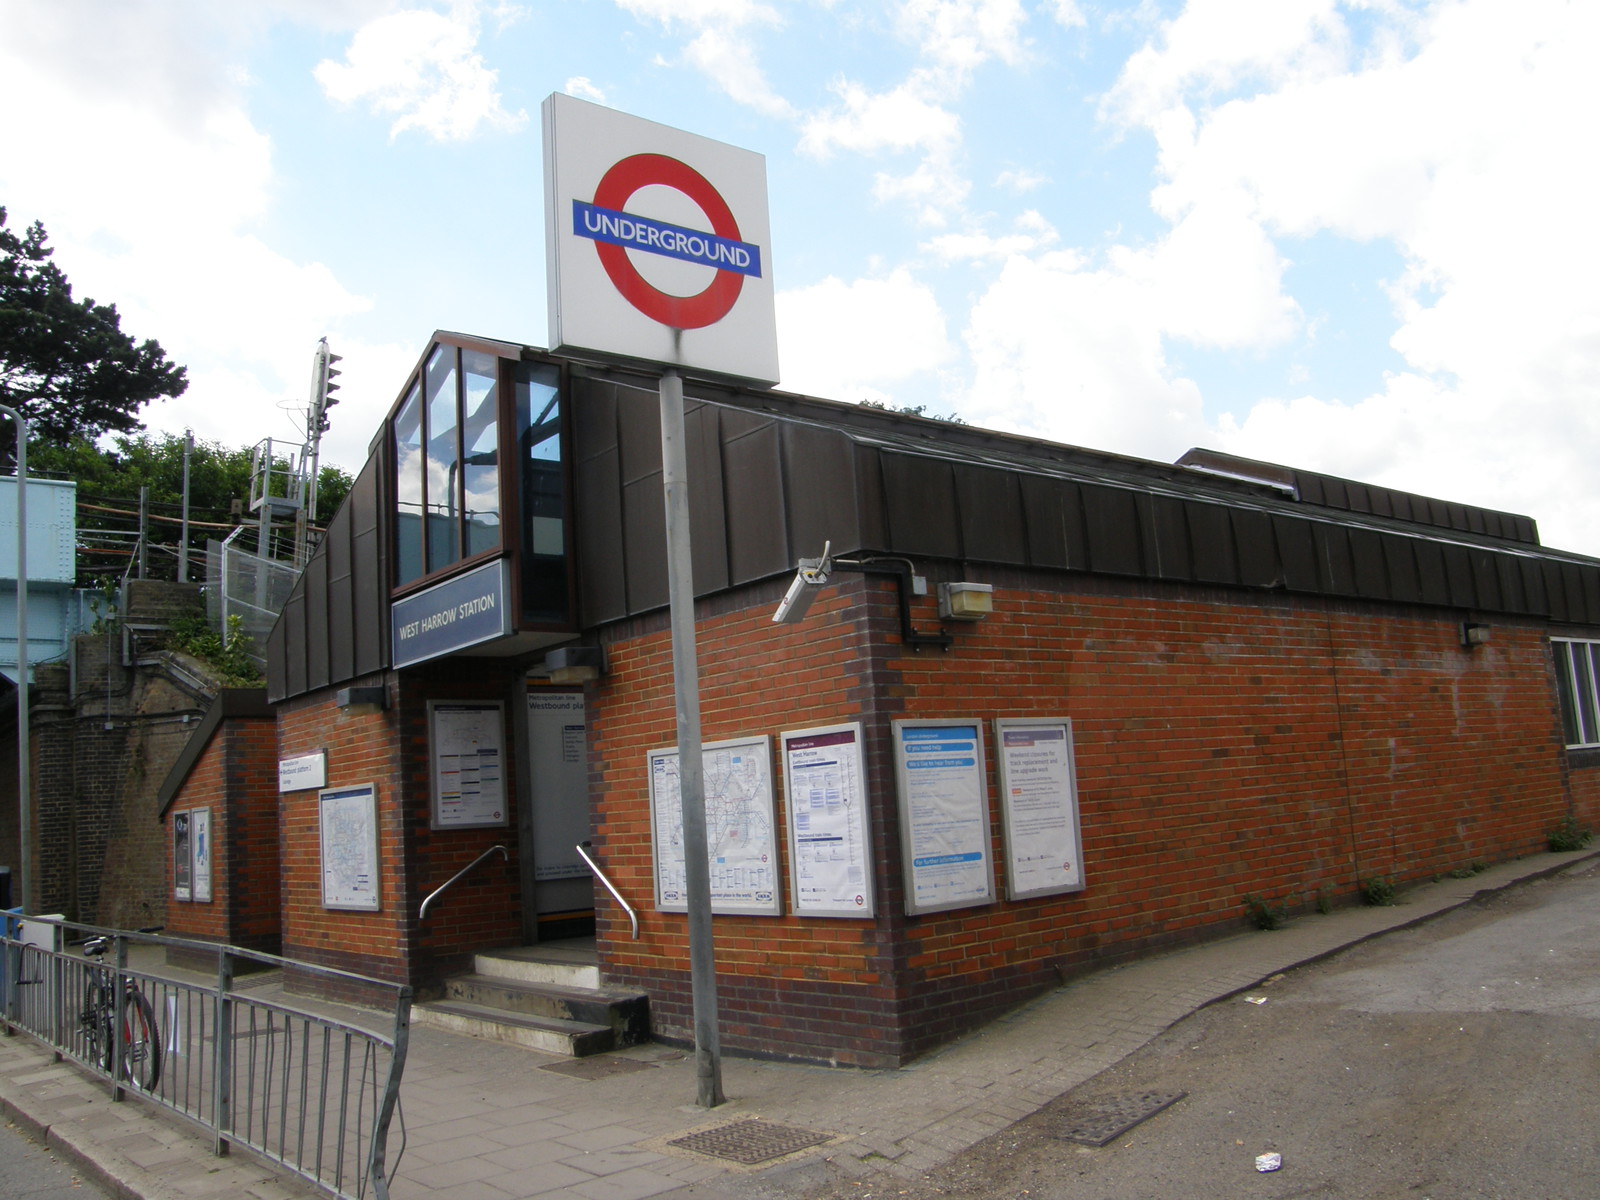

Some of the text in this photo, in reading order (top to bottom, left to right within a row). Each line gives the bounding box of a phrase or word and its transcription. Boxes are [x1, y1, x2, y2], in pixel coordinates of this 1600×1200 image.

[584, 210, 751, 268] UNDERGROUND
[400, 593, 495, 640] WEST HARROW STATION
[529, 702, 584, 710] Westbound pla
